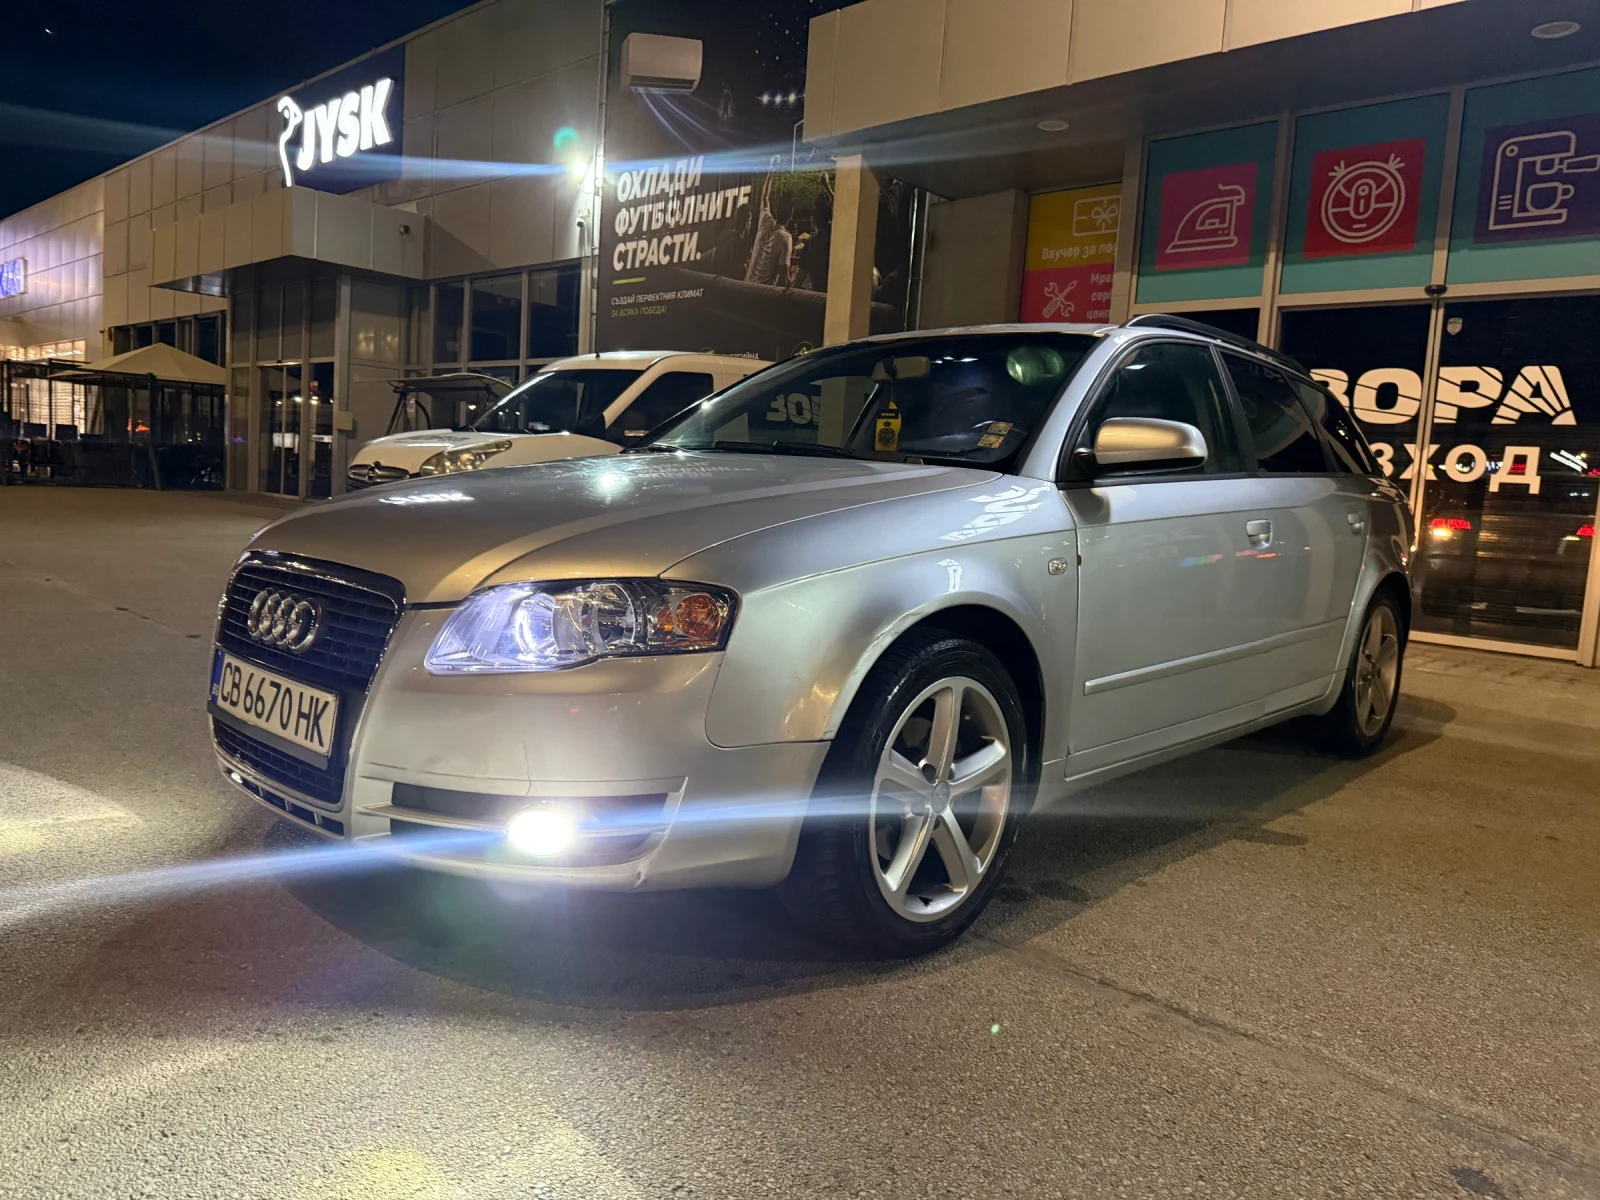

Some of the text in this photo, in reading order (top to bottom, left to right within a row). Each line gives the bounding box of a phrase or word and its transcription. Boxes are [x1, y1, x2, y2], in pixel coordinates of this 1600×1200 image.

[297, 78, 392, 171] JYSK
[617, 155, 704, 202] ОХЛАДИ
[613, 231, 702, 271] СТРАСТИ.
[1042, 247, 1080, 261] Ваучер
[1082, 244, 1096, 258] за
[677, 288, 704, 299] КЛИМАТ
[1090, 272, 1114, 285] Мре
[243, 672, 293, 731] 6670
